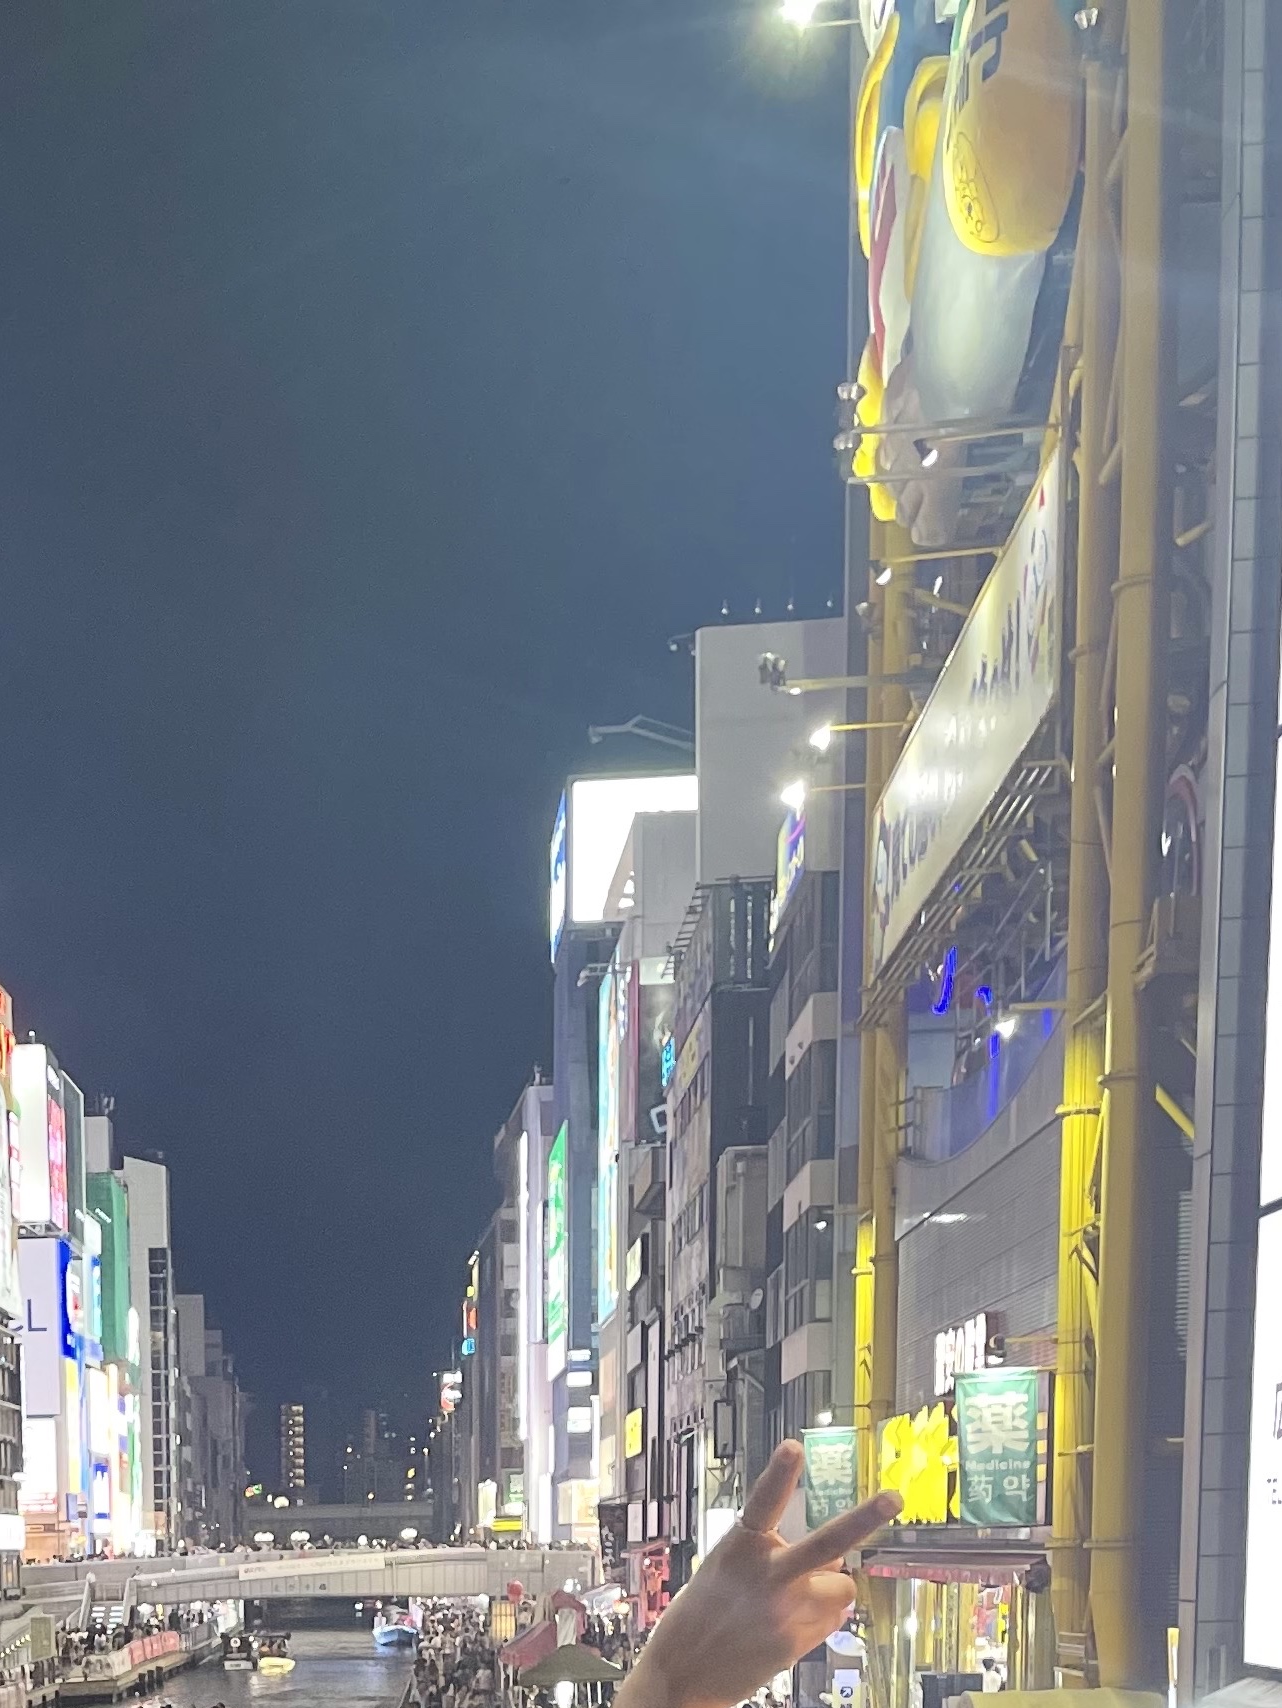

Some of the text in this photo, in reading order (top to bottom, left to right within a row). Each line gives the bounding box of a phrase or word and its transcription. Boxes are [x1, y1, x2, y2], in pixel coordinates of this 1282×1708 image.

[965, 1391, 1030, 1454] 薬
[810, 1442, 853, 1486] 薬
[965, 1459, 1031, 1471] Medicine
[1003, 1474, 1031, 1502] 약
